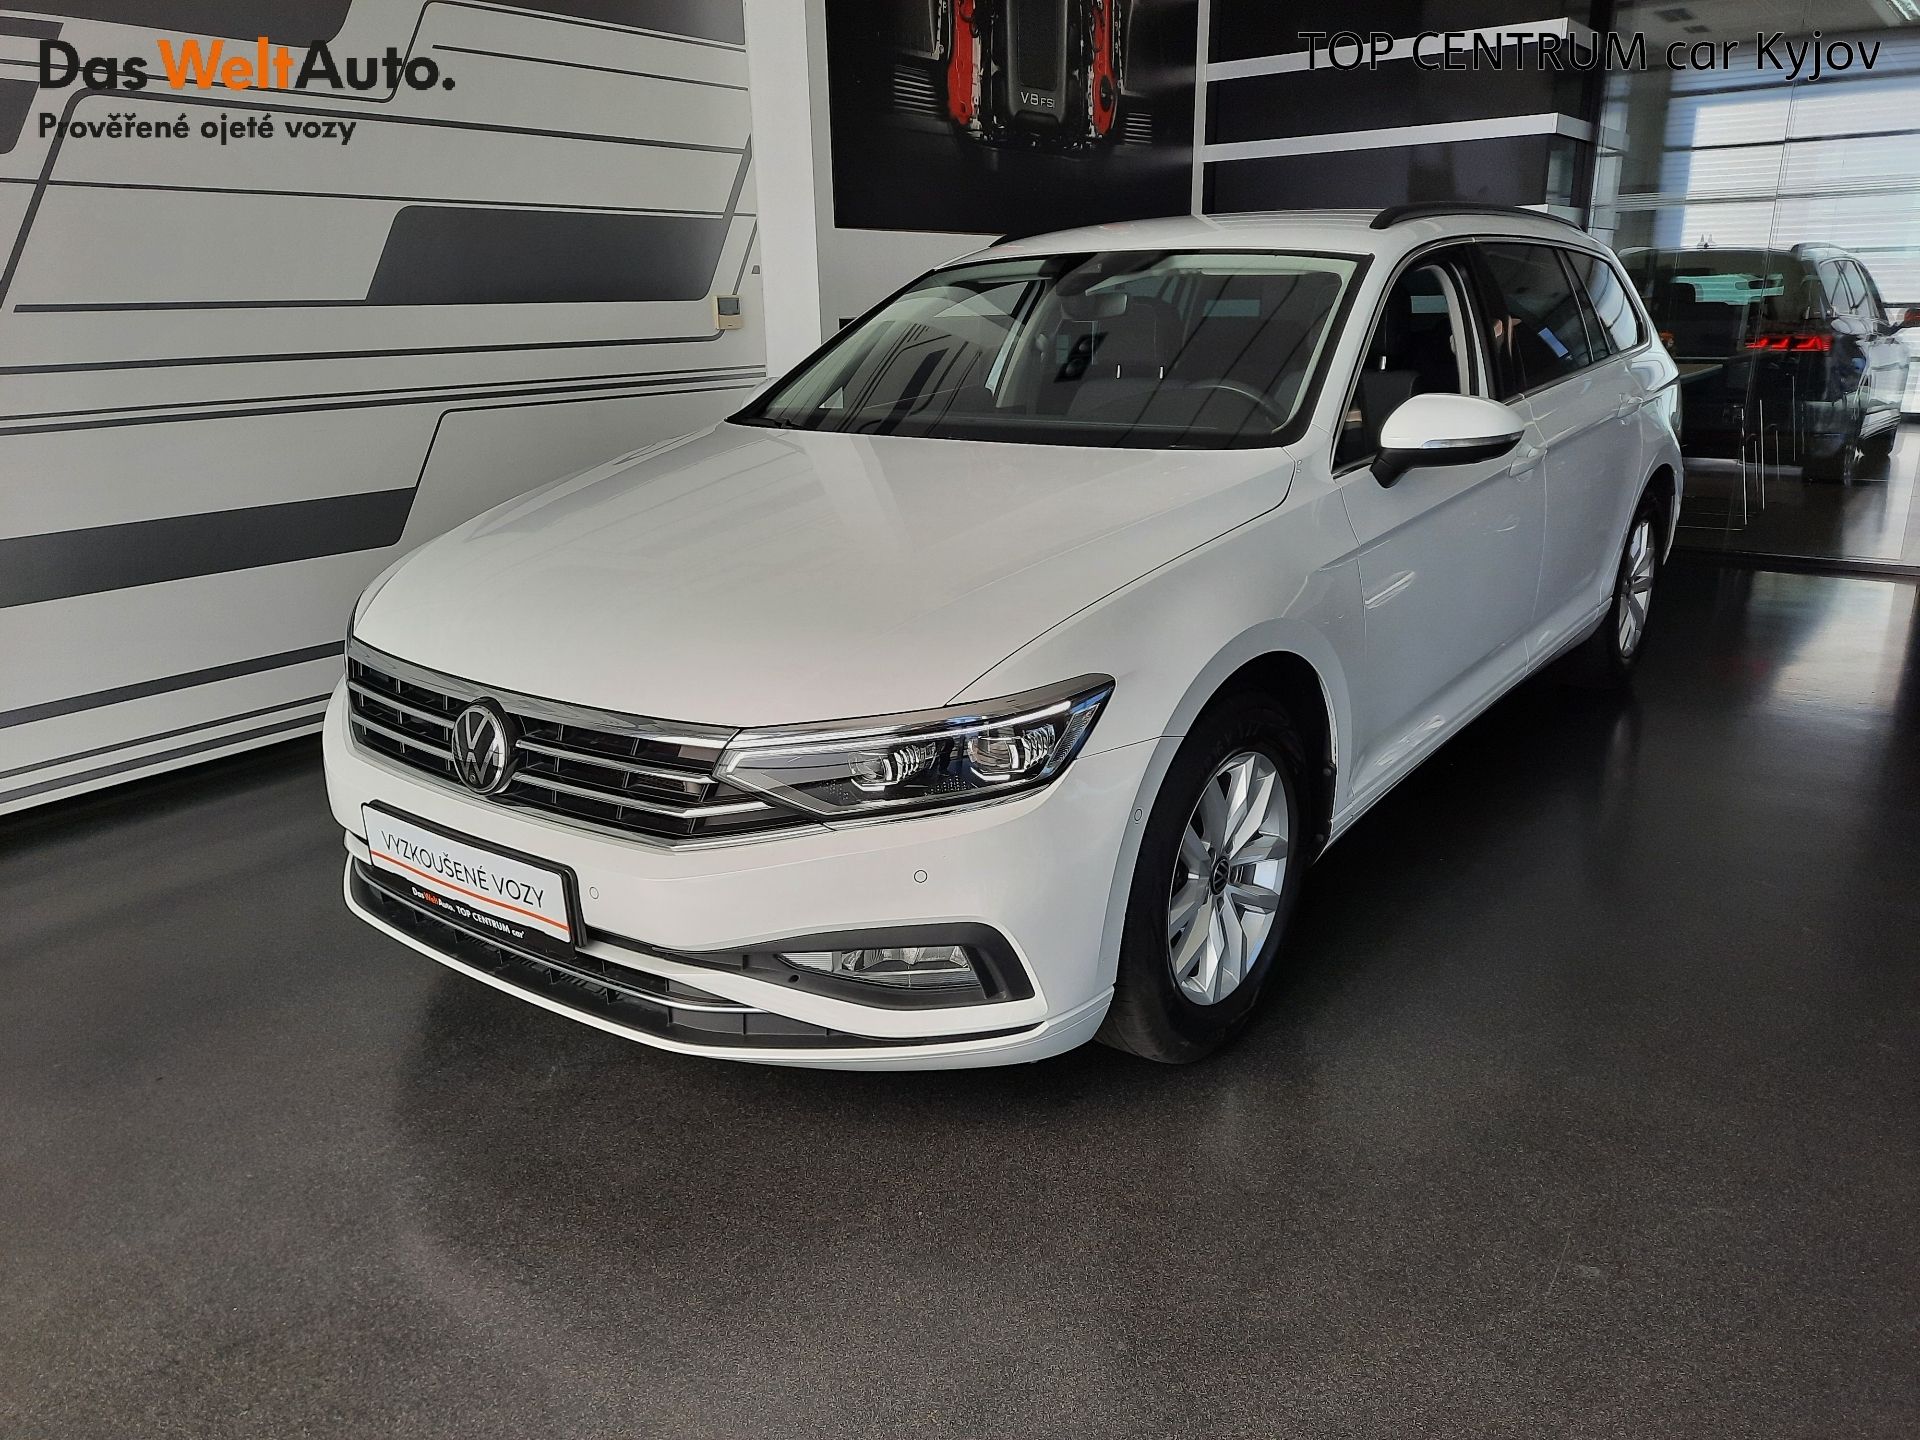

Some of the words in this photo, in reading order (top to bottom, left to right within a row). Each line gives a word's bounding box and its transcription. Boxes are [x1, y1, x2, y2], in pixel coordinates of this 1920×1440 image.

[381, 830, 490, 892] VYZKOUŠENÉ
[491, 873, 545, 909] VOZY
[456, 905, 471, 918] TOP
[472, 912, 511, 934] CENTRUM
